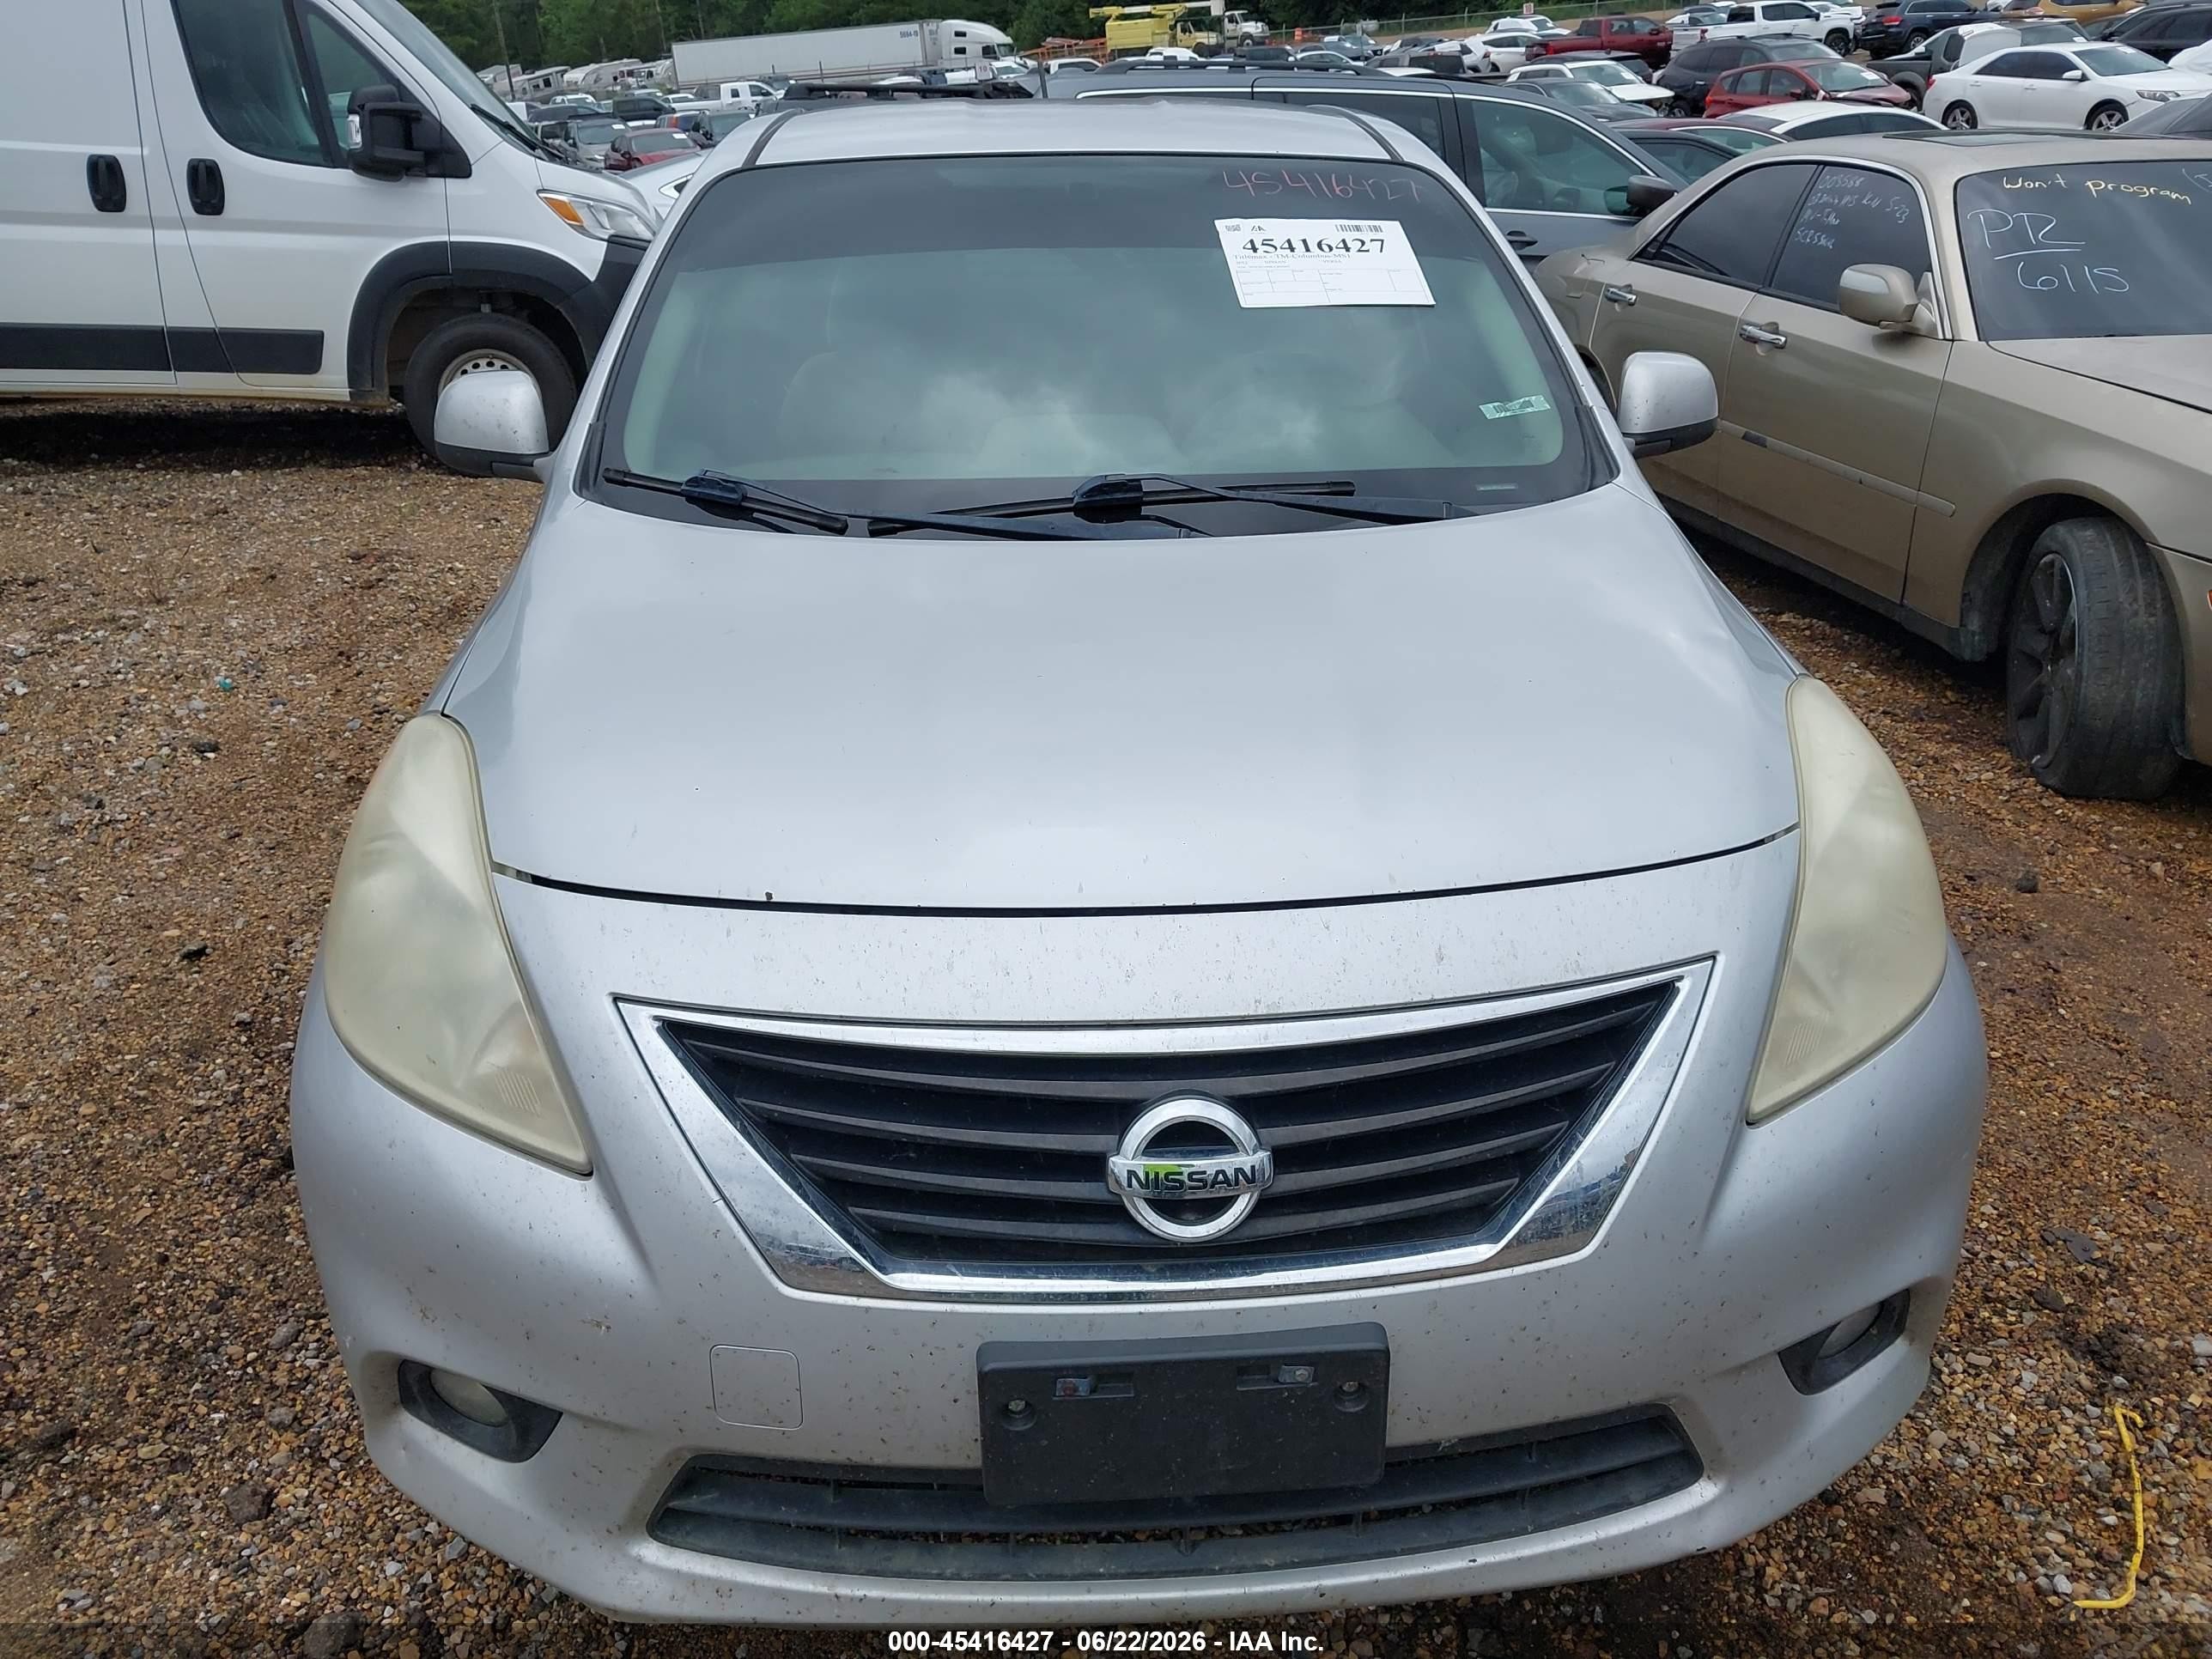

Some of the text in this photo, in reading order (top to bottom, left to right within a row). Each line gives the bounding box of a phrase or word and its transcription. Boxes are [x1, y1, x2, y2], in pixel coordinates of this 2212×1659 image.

[1223, 170, 1422, 203] 45416427
[2003, 173, 2068, 188] Won't
[2085, 179, 2192, 204] program
[1243, 238, 1385, 253] 45416427
[1126, 1164, 1256, 1192] NISSAN
